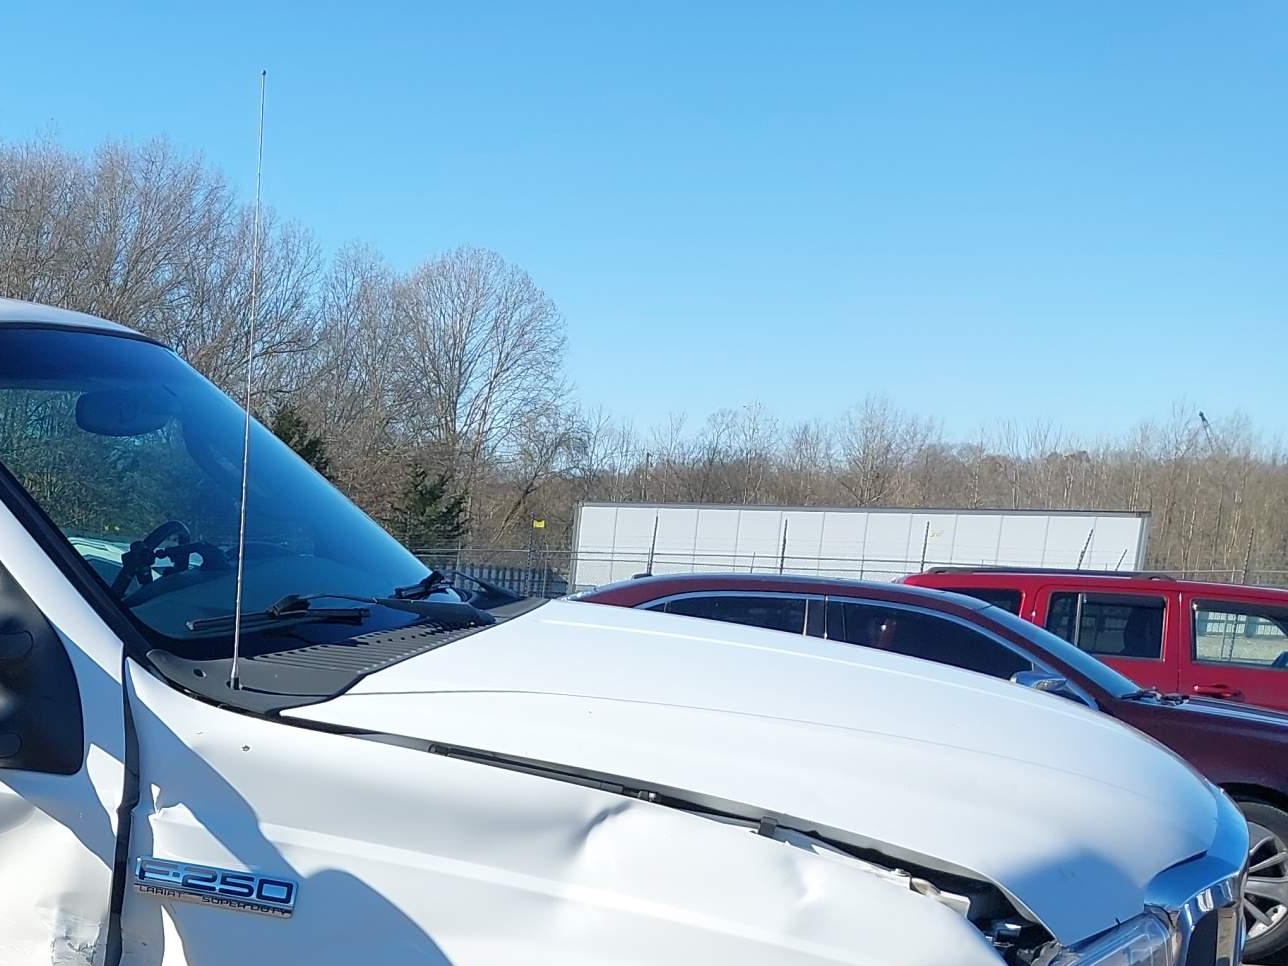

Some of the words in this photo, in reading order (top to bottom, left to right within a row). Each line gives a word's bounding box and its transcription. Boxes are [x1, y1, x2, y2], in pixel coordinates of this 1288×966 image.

[138, 860, 293, 903] F-250
[139, 885, 185, 898] LARIAT
[201, 895, 248, 909] SUPER
[250, 902, 288, 915] DUTY
